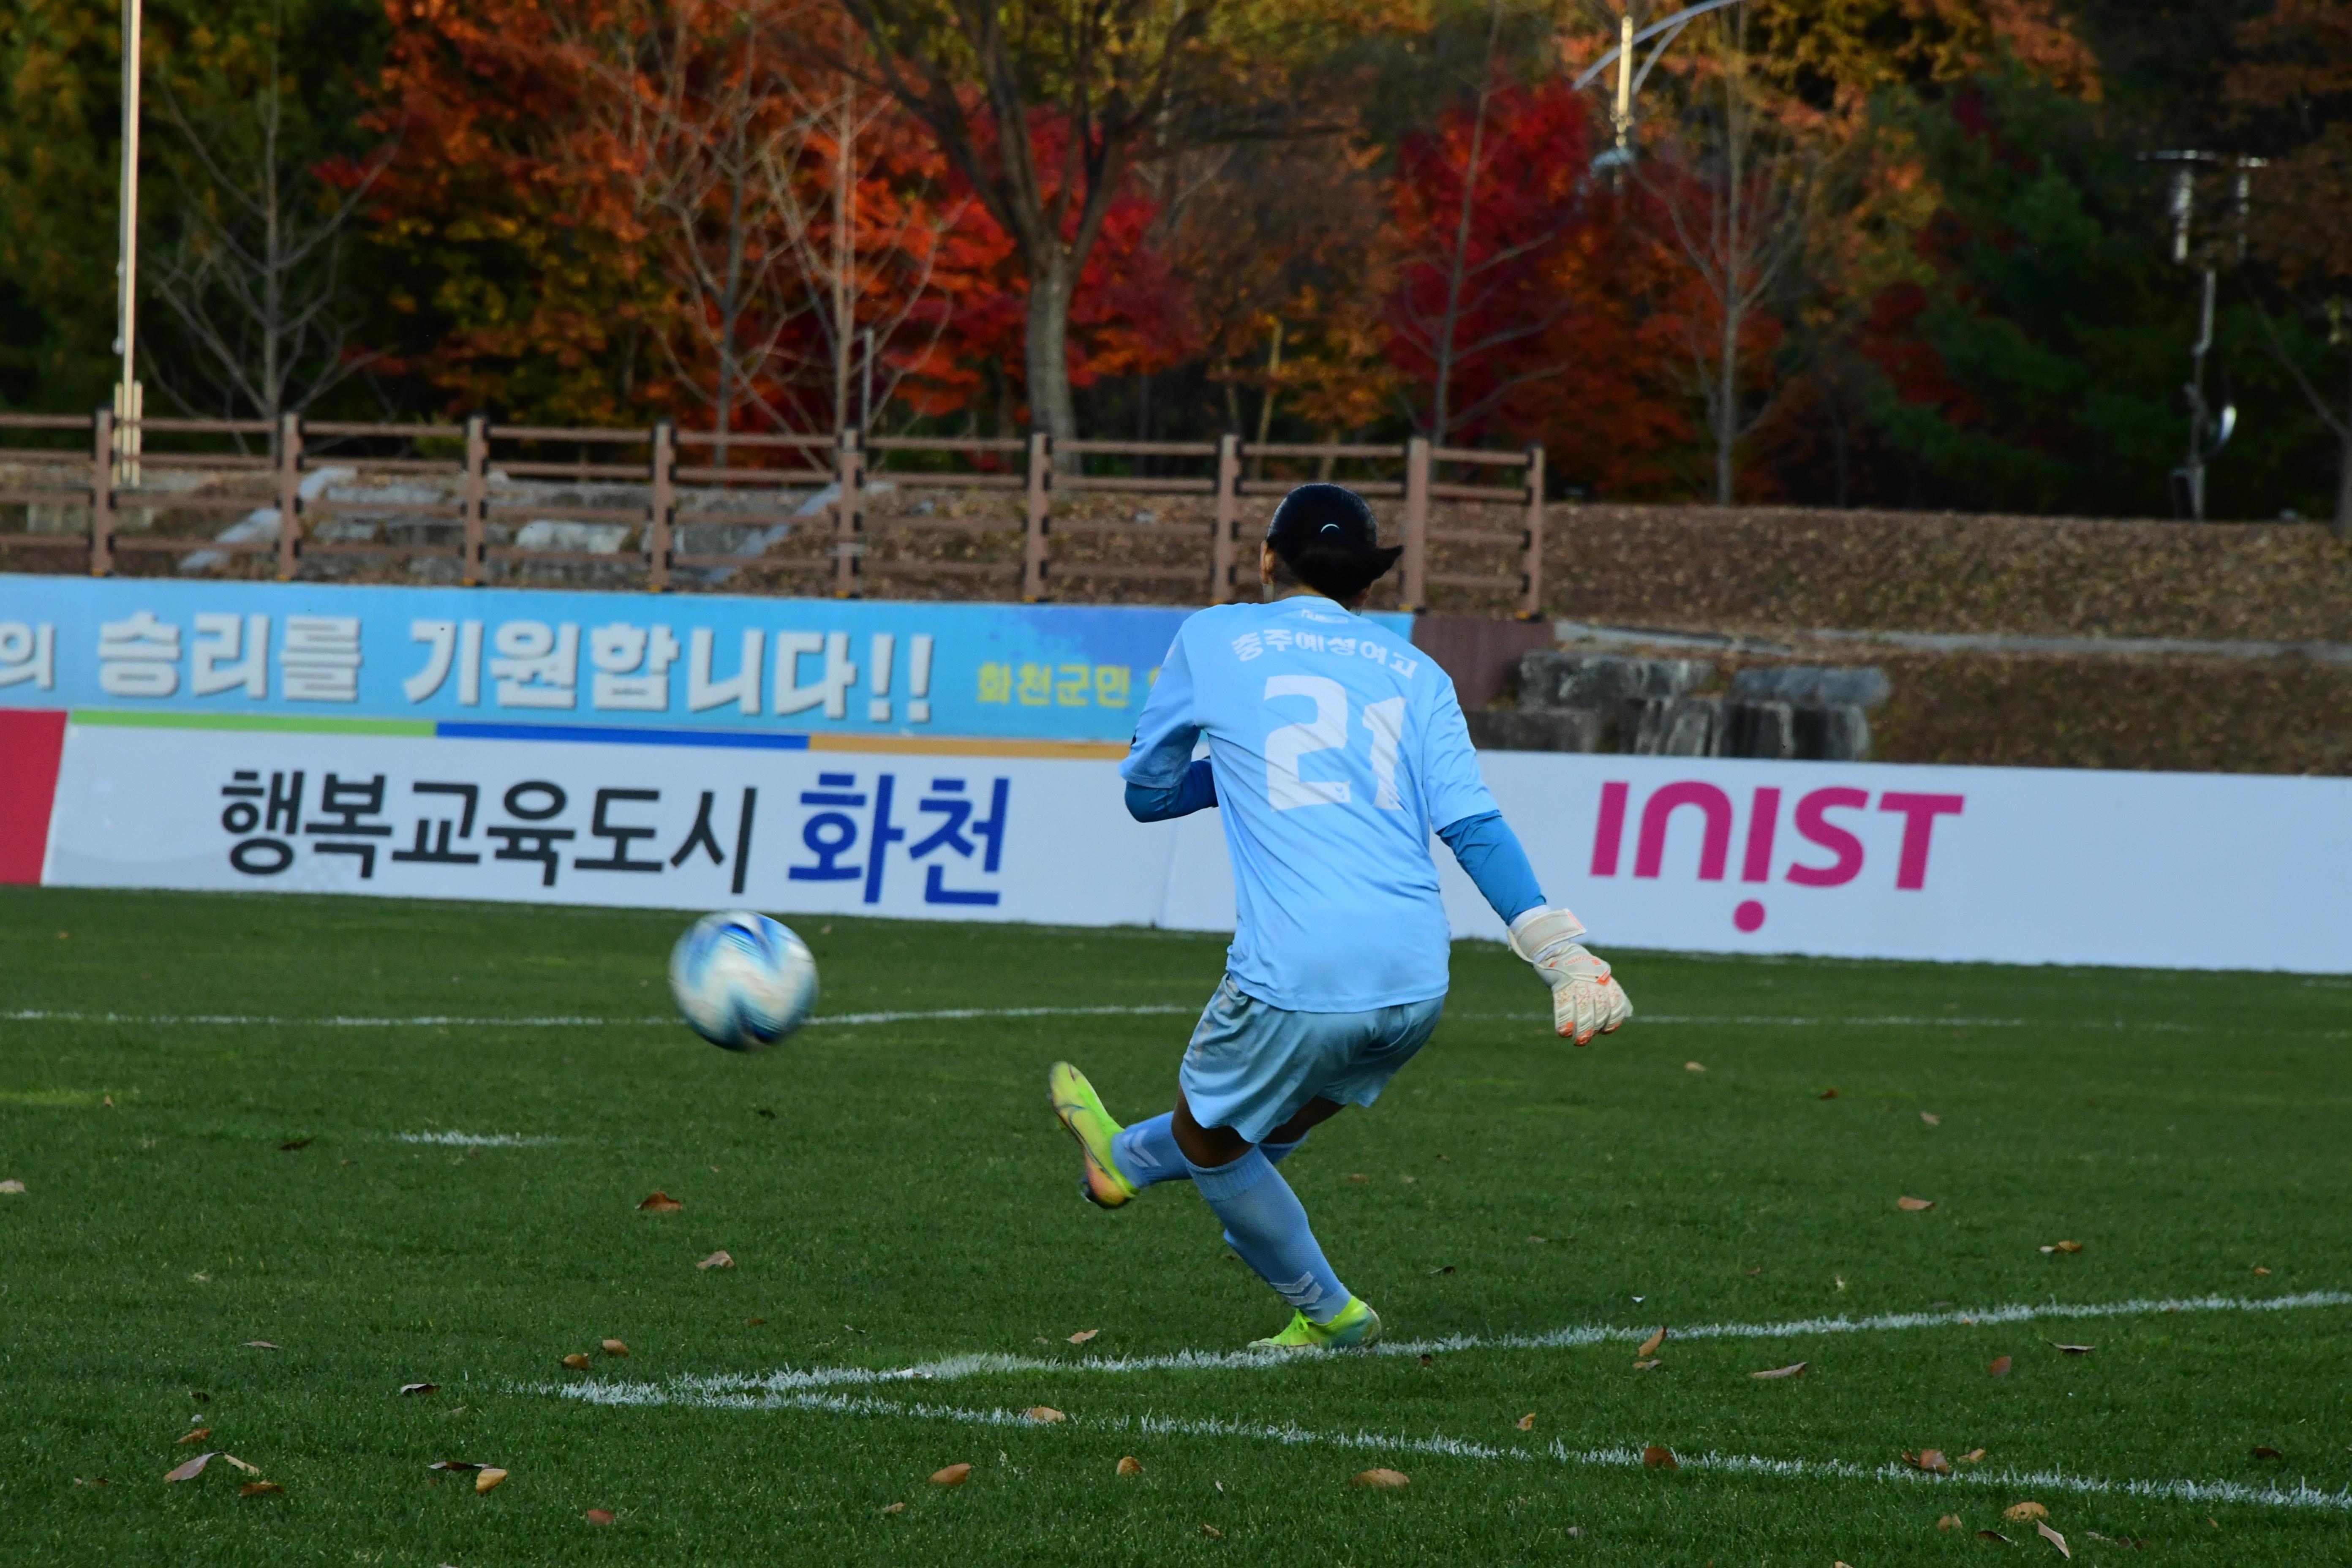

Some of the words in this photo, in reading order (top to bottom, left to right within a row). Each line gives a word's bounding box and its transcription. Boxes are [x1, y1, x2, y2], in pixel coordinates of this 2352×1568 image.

[0, 622, 54, 690] 의
[98, 611, 362, 702] 승리를
[404, 619, 932, 722] 기원합니다!!
[977, 662, 1131, 708] 화천군민
[1232, 629, 1418, 680] 충주예성여고
[1263, 675, 1407, 812] 21
[222, 770, 757, 894] 행복교육도시
[788, 773, 1009, 905] 화천
